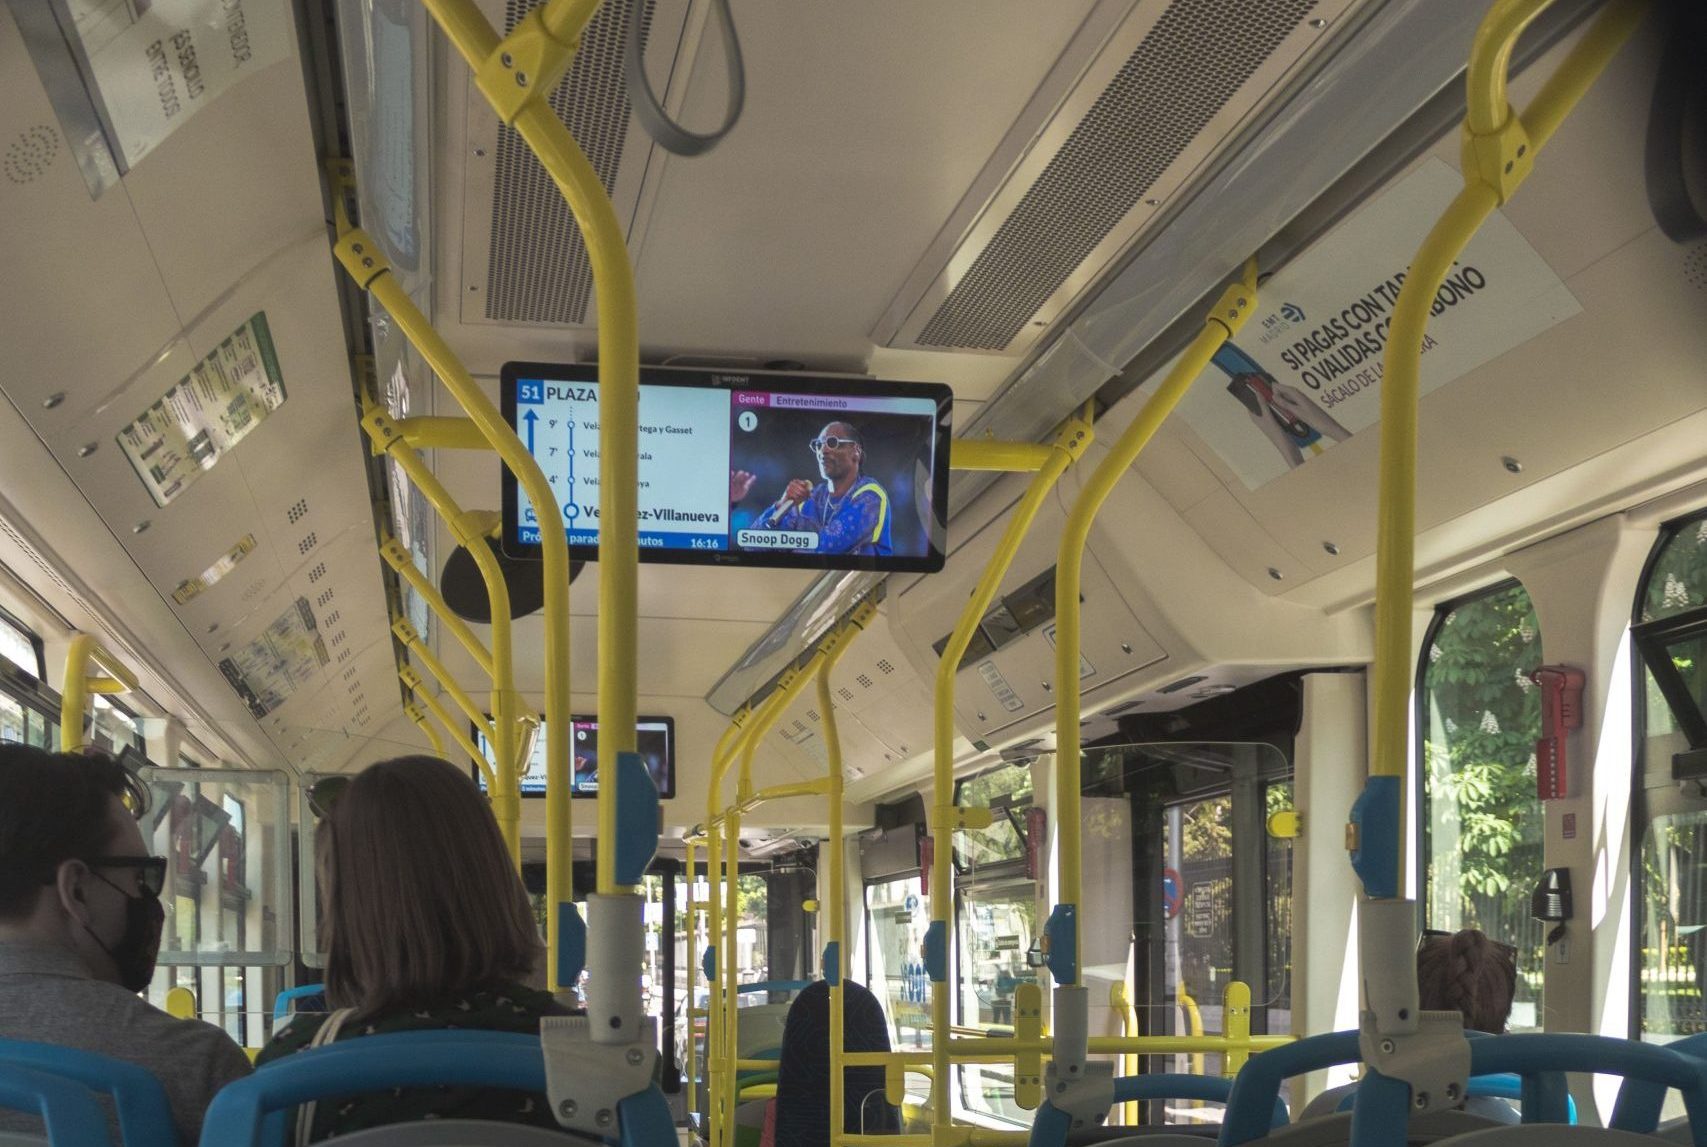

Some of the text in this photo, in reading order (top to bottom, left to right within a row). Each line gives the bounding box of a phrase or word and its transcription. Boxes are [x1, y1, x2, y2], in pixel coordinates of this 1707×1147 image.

[1281, 349, 1304, 371] SI
[1293, 318, 1349, 361] PAGAS
[1341, 293, 1386, 330] CON
[1301, 371, 1320, 390] O
[1311, 331, 1382, 382] VALIDAS
[1429, 266, 1486, 318] BONO
[521, 385, 598, 402] 51 PLAZA
[1320, 379, 1361, 408] SÁCALO
[1356, 369, 1377, 387] DE
[738, 394, 848, 409] Gente Entretenimiento
[665, 425, 693, 435] Gasset
[690, 538, 719, 549] 16:16
[741, 532, 810, 548] Snoop Dogg
